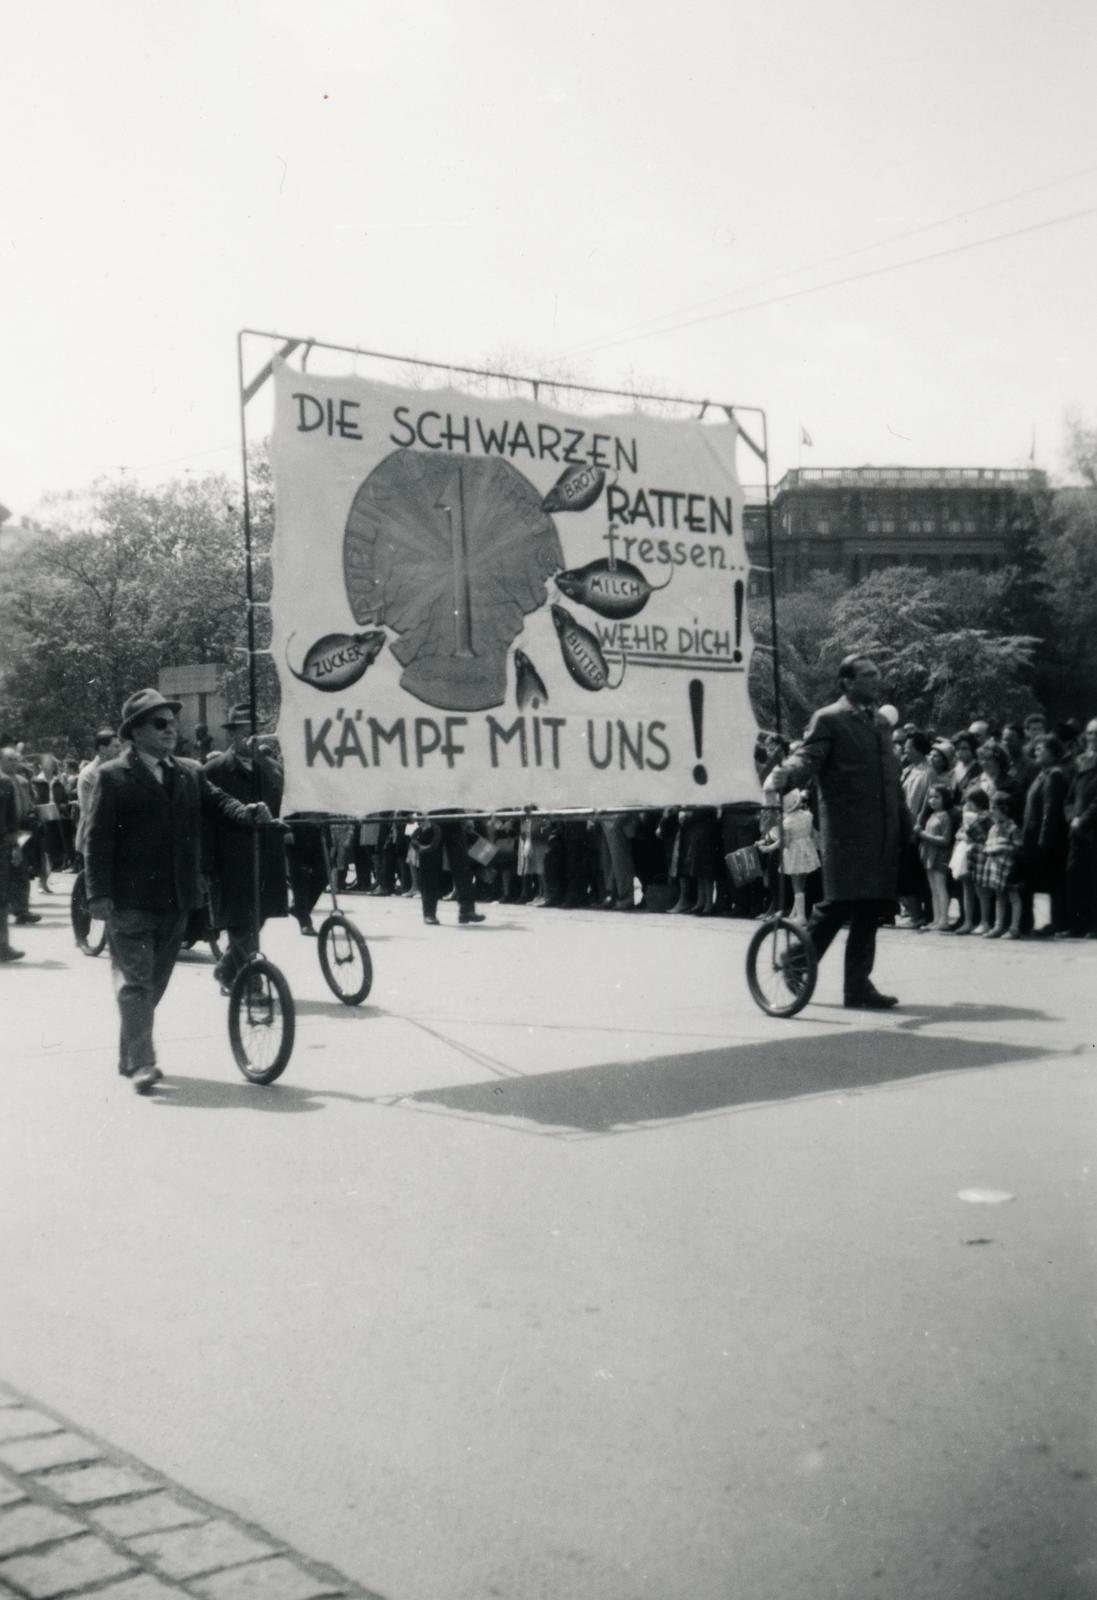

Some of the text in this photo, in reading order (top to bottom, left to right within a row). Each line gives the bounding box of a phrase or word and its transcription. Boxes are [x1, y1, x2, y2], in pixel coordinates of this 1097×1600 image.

[292, 393, 639, 474] DIE SCHWARZEN
[563, 466, 597, 499] BROT
[606, 485, 733, 536] RATTEN
[590, 578, 641, 597] MILCH
[565, 631, 603, 684] BUTTER
[594, 621, 669, 652] WEHR
[312, 644, 365, 678] ZUCKER
[304, 708, 468, 768] KÄMPF
